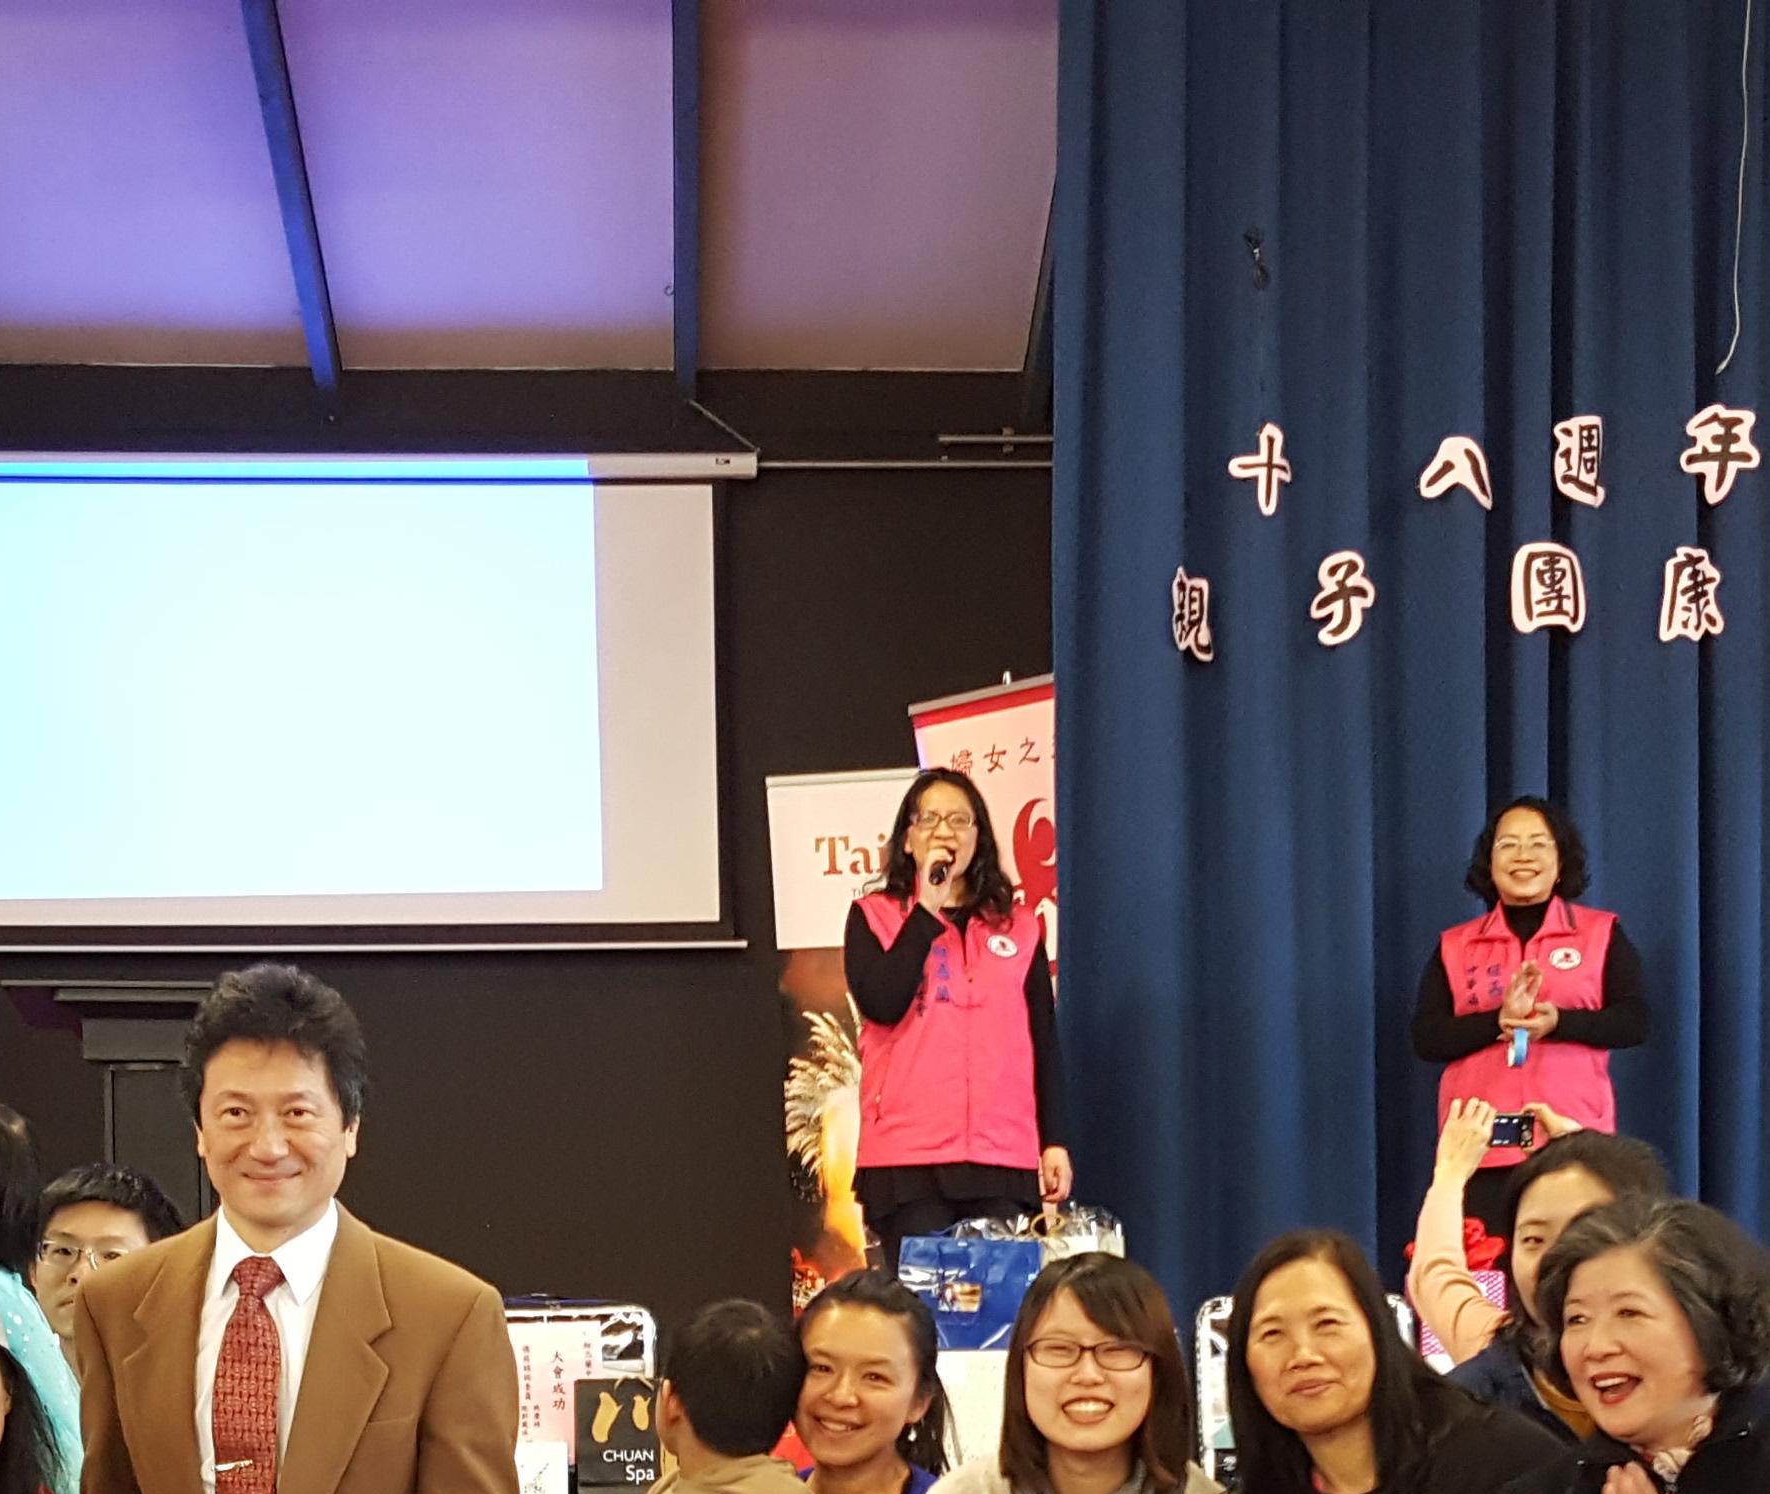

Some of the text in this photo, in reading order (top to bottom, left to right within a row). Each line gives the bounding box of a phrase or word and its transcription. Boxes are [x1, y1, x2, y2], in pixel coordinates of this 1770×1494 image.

[950, 737, 1056, 776] 婦女之
[602, 1449, 655, 1463] CHUAN
[625, 1464, 655, 1486] Spa
